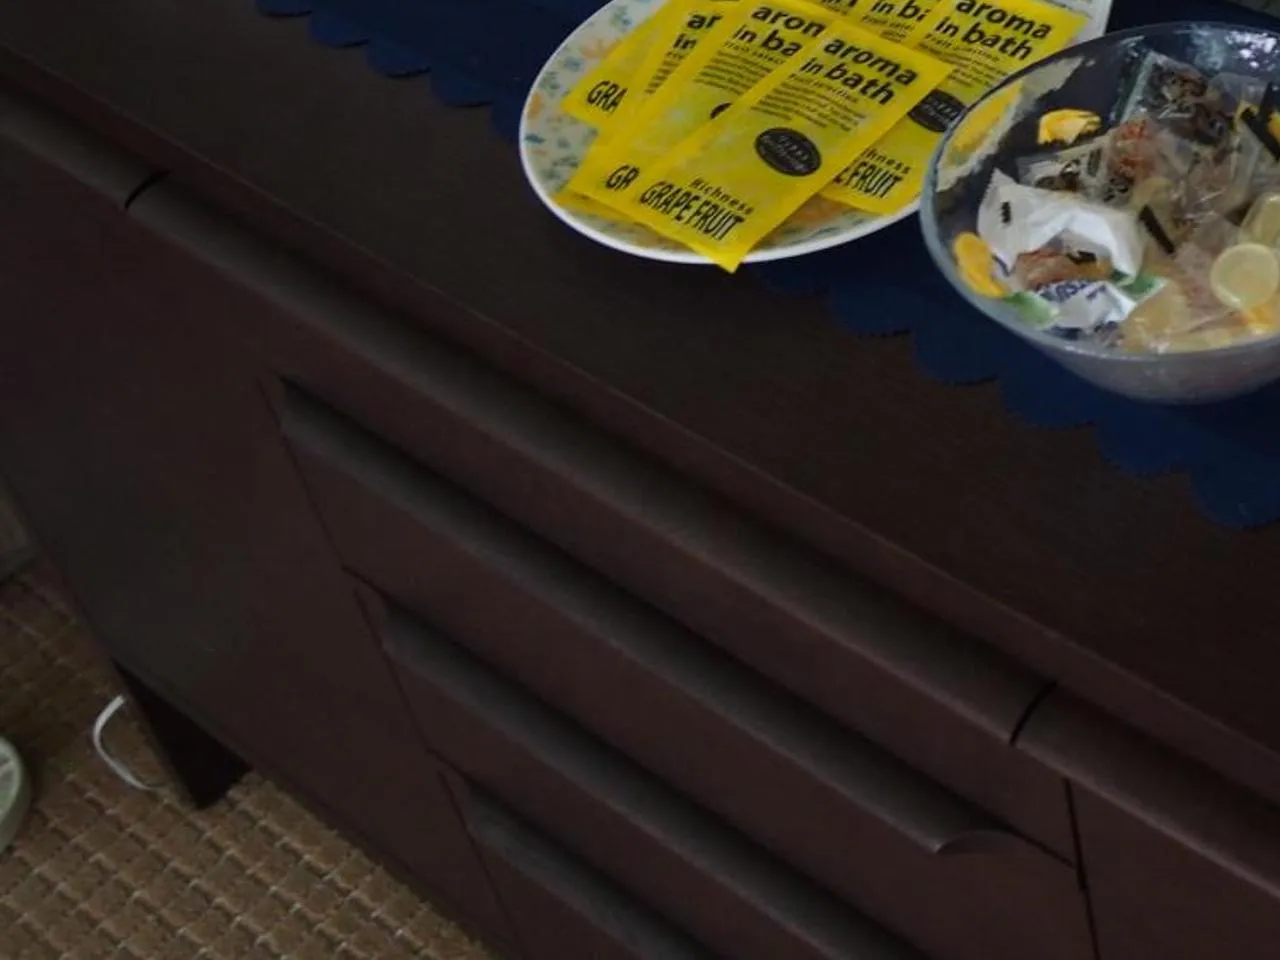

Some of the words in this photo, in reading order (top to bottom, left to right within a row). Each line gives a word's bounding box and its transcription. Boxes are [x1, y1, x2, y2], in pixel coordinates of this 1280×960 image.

[732, 24, 757, 44] in
[935, 16, 960, 39] in
[962, 21, 1034, 61] bath
[800, 58, 824, 75] in
[825, 63, 895, 105] bath
[823, 38, 918, 86] aroma
[639, 180, 700, 222] GRAPE
[690, 199, 746, 241] FRUIT
[689, 178, 755, 216] Richness
